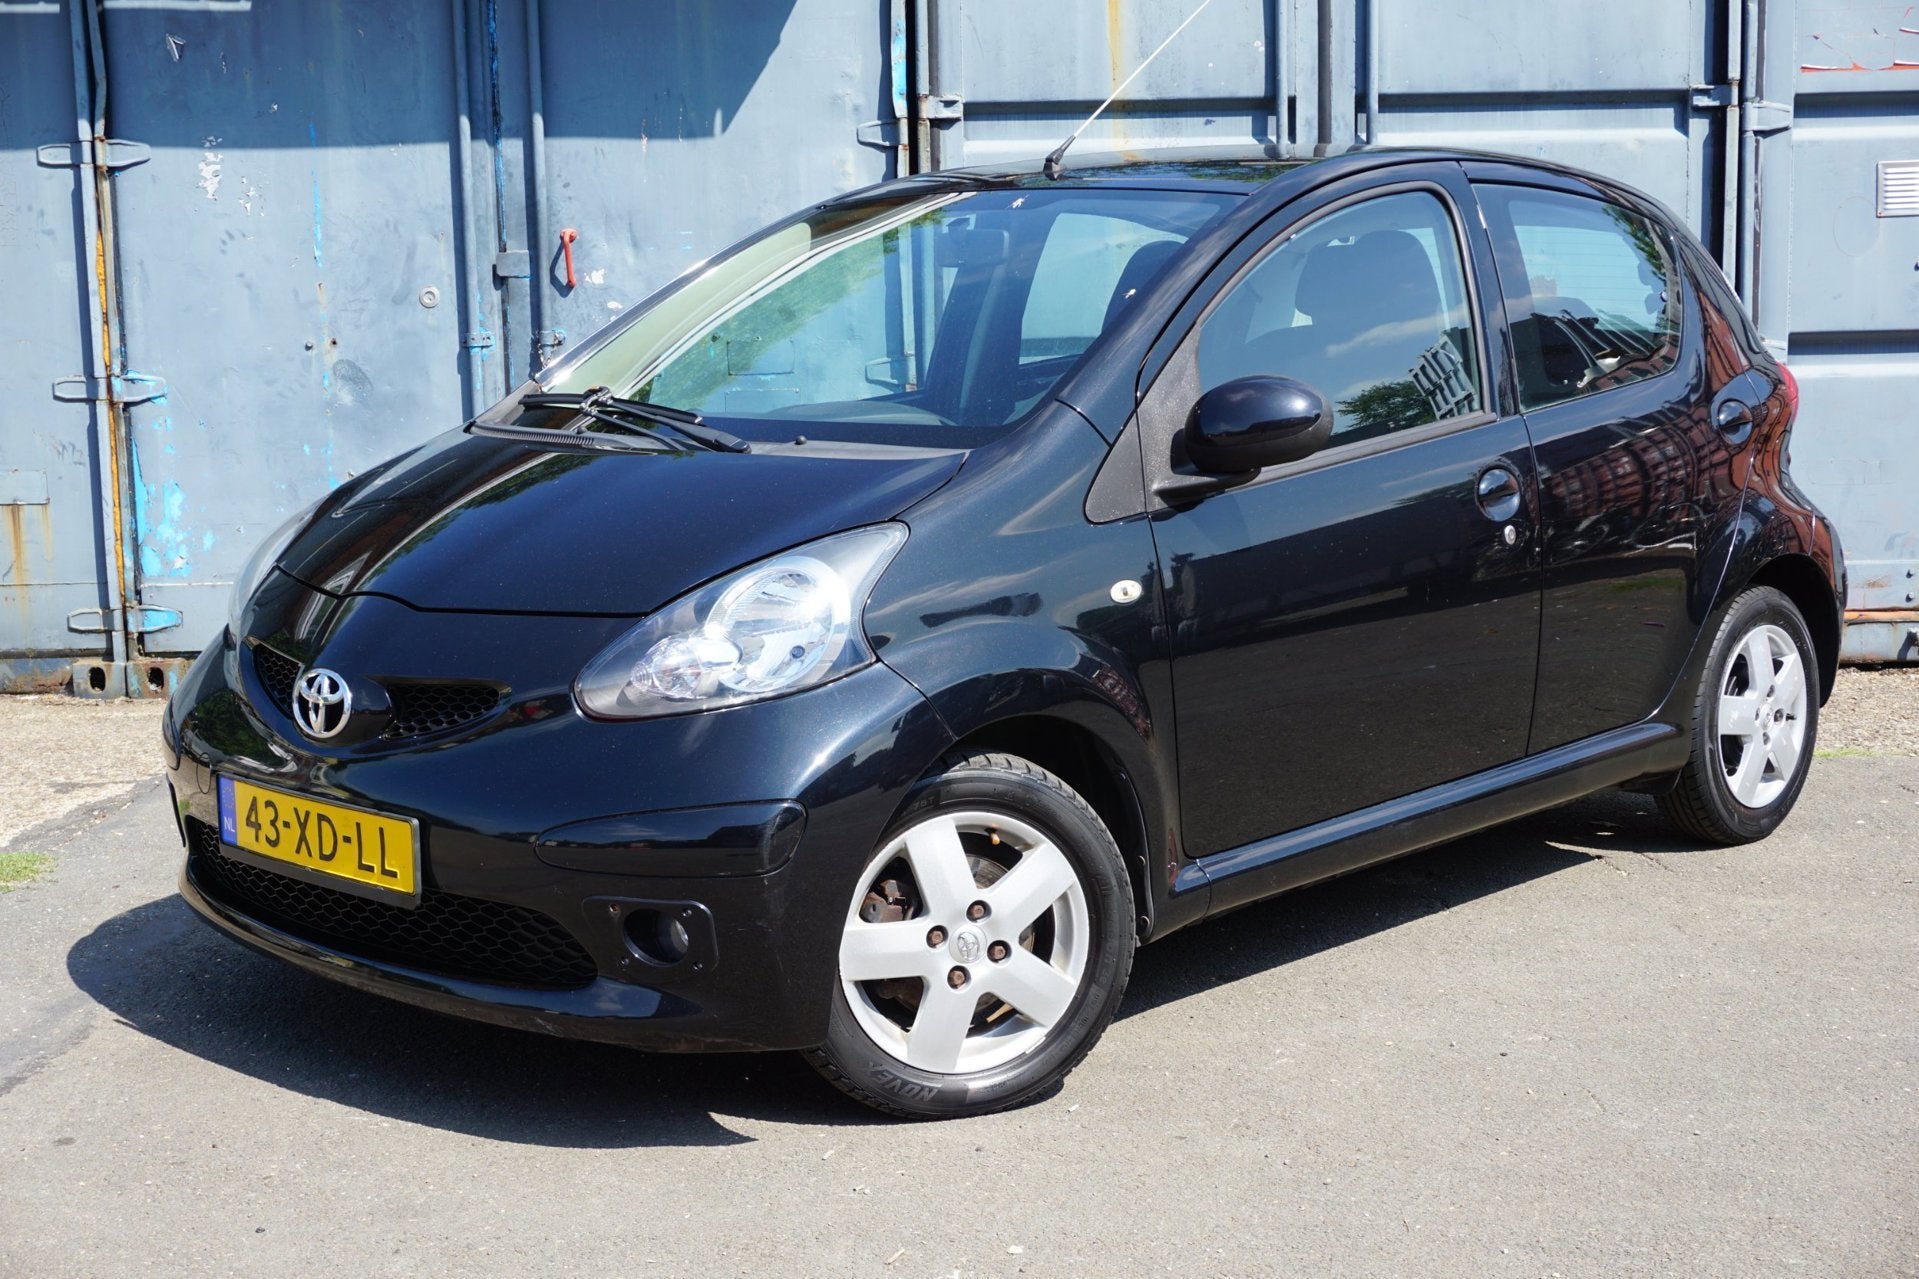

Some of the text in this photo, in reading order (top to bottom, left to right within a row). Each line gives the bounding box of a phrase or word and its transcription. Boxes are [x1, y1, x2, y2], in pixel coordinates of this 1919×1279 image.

[224, 816, 235, 833] NL
[245, 796, 398, 879] 43-XD-LL
[867, 1061, 939, 1101] NOVEX
